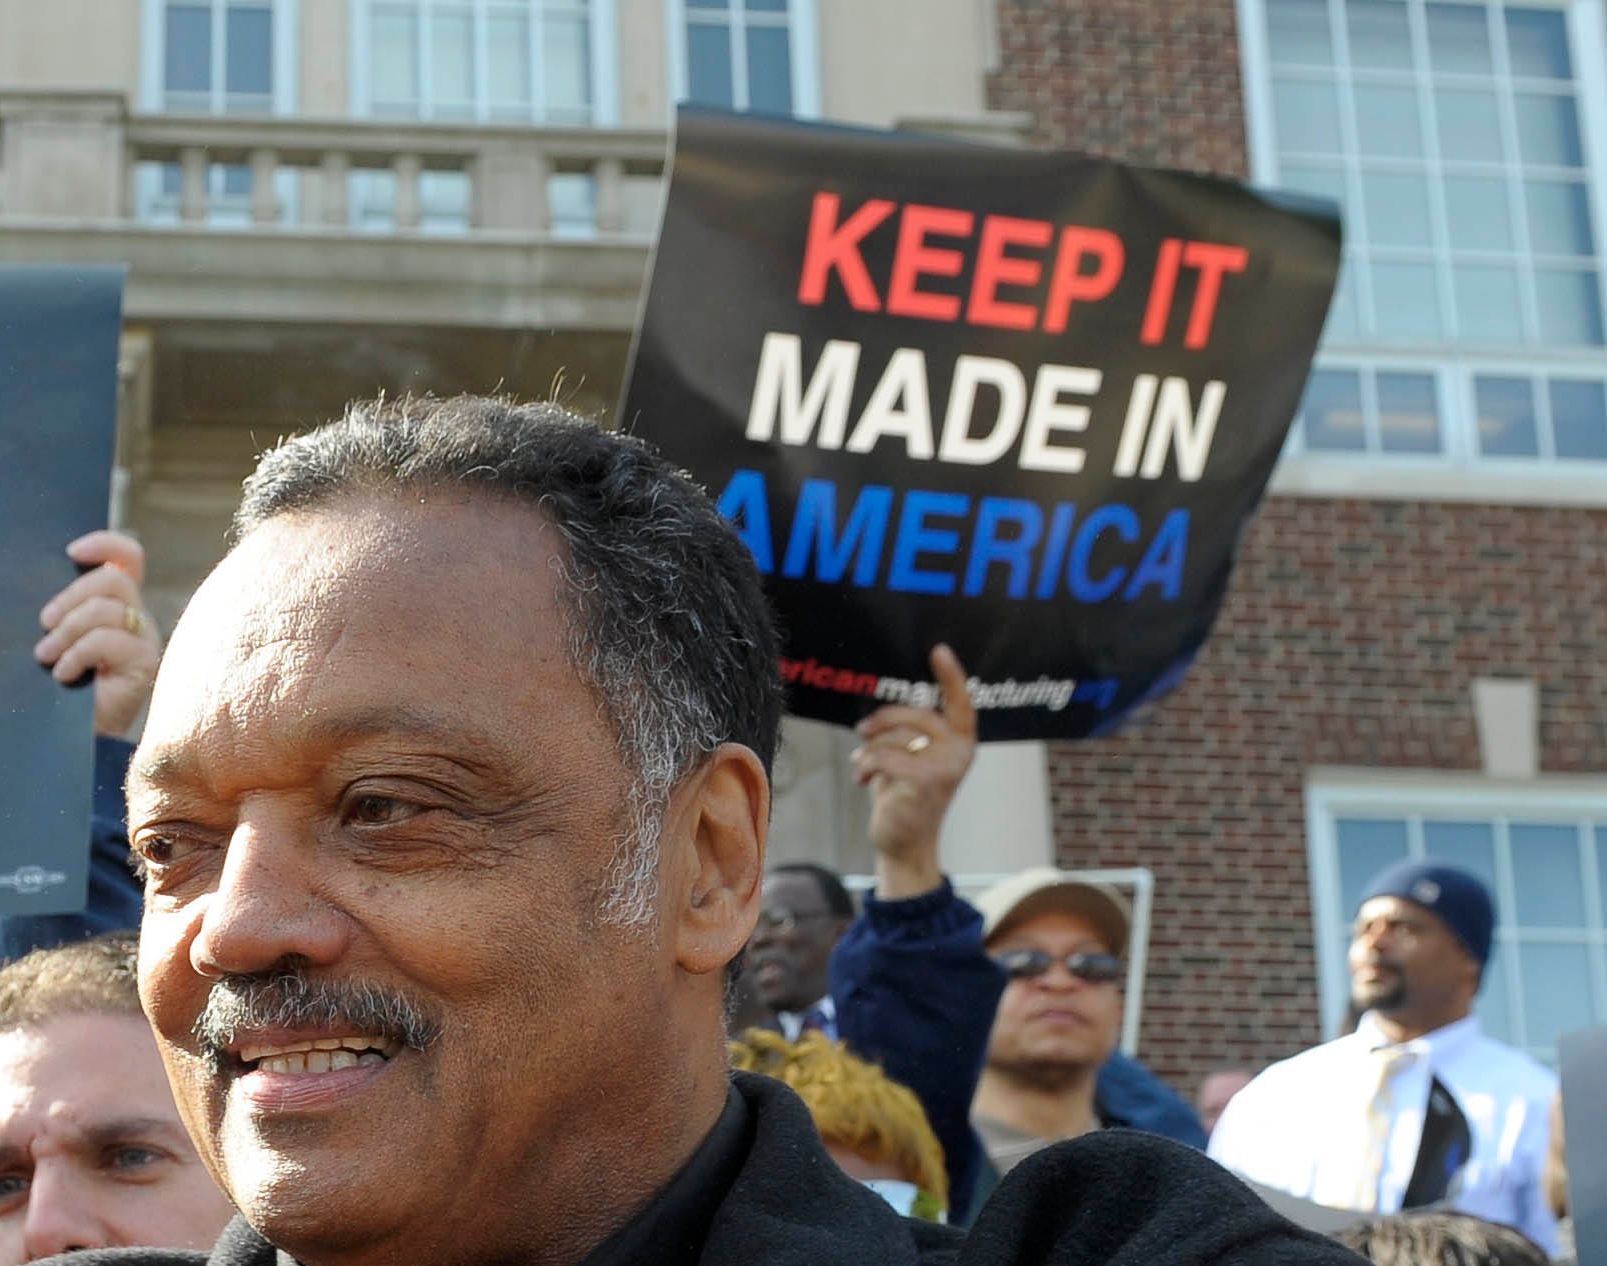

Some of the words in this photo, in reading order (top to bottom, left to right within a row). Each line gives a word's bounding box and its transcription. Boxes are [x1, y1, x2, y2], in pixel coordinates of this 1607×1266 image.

[797, 191, 1126, 335] KEEP
[1140, 238, 1249, 350] IT
[745, 332, 1102, 473] MADE
[1113, 374, 1226, 481] IN
[717, 469, 1190, 602] AMERICA
